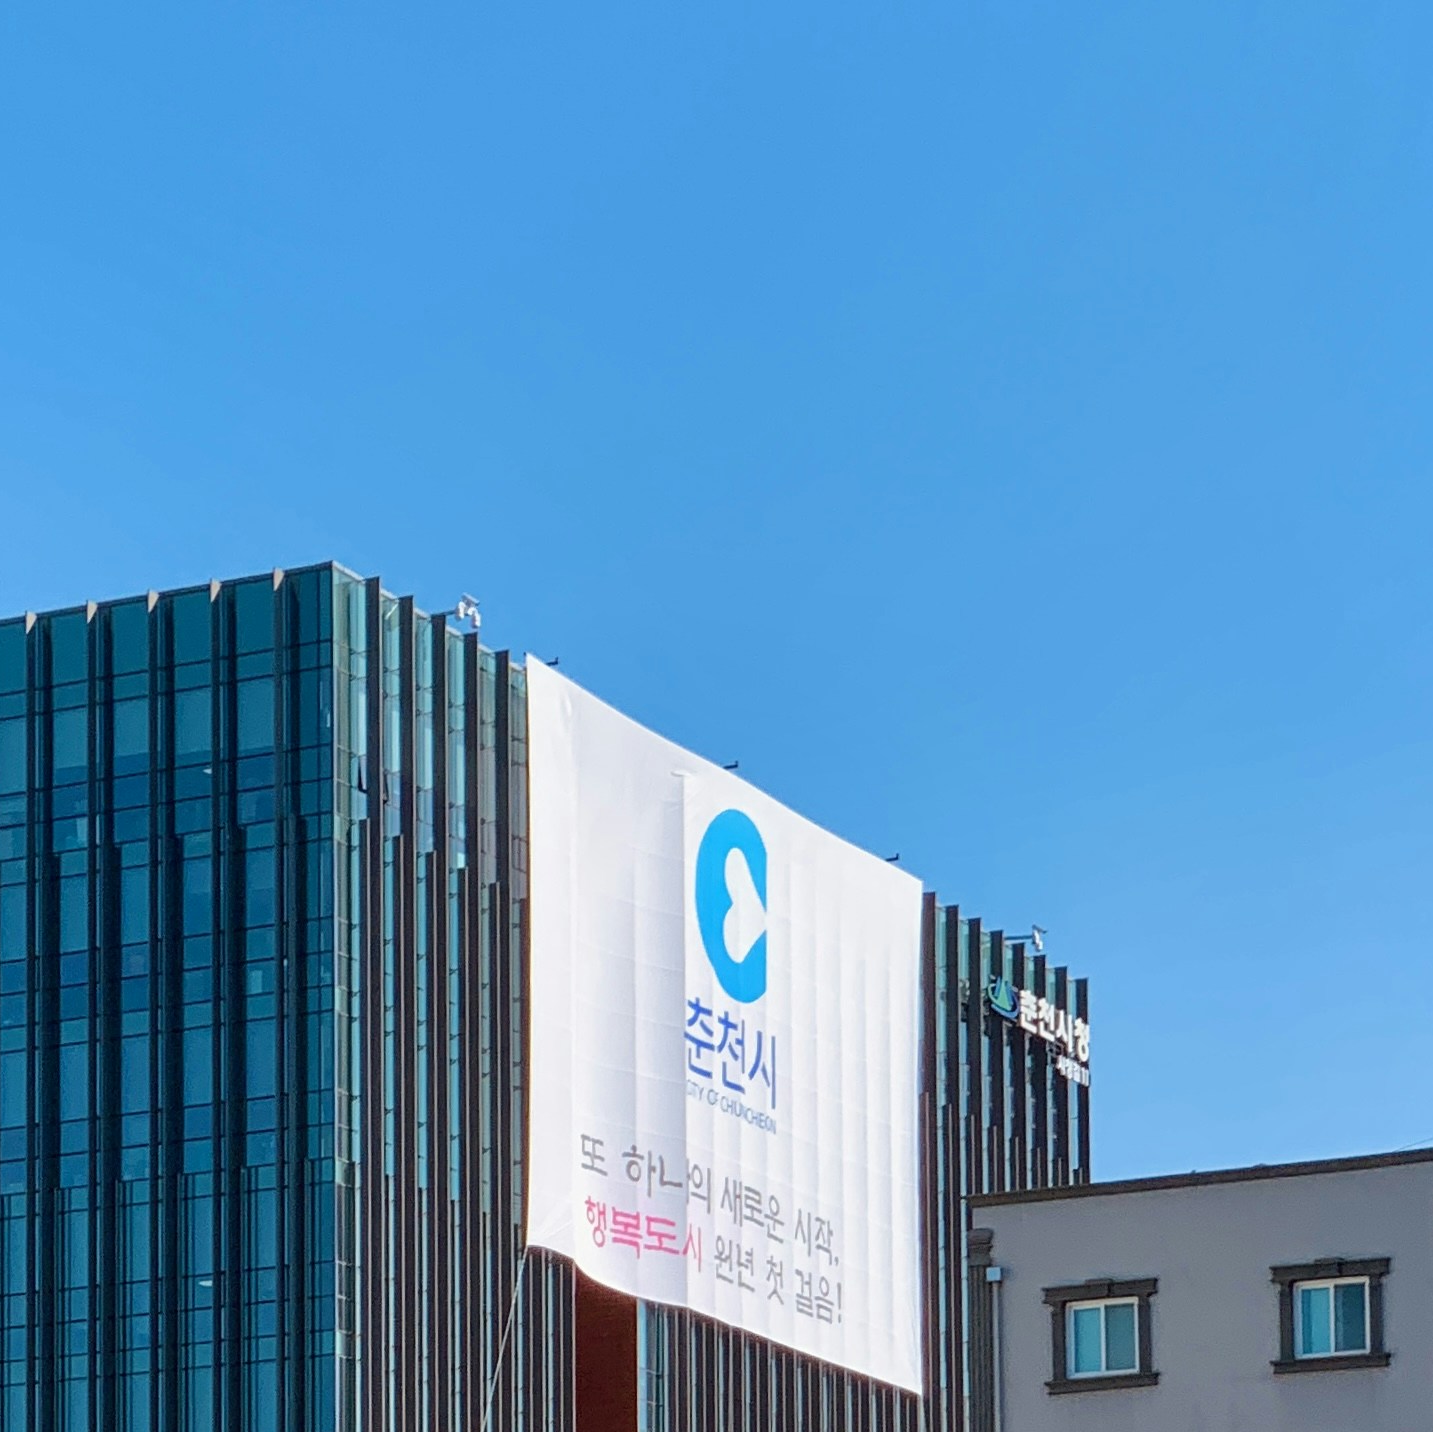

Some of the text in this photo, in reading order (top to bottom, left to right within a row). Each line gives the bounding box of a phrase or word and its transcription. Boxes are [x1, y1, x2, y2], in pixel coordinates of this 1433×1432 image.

[684, 997, 776, 1109] 춘천시
[1020, 990, 1089, 1062] 춘천시청
[720, 1096, 776, 1135] CHUNCHEON
[581, 1134, 839, 1266] 또 하나의 새로운 시작,
[585, 1196, 842, 1324] 행복도시 원년 첫 걸음!
